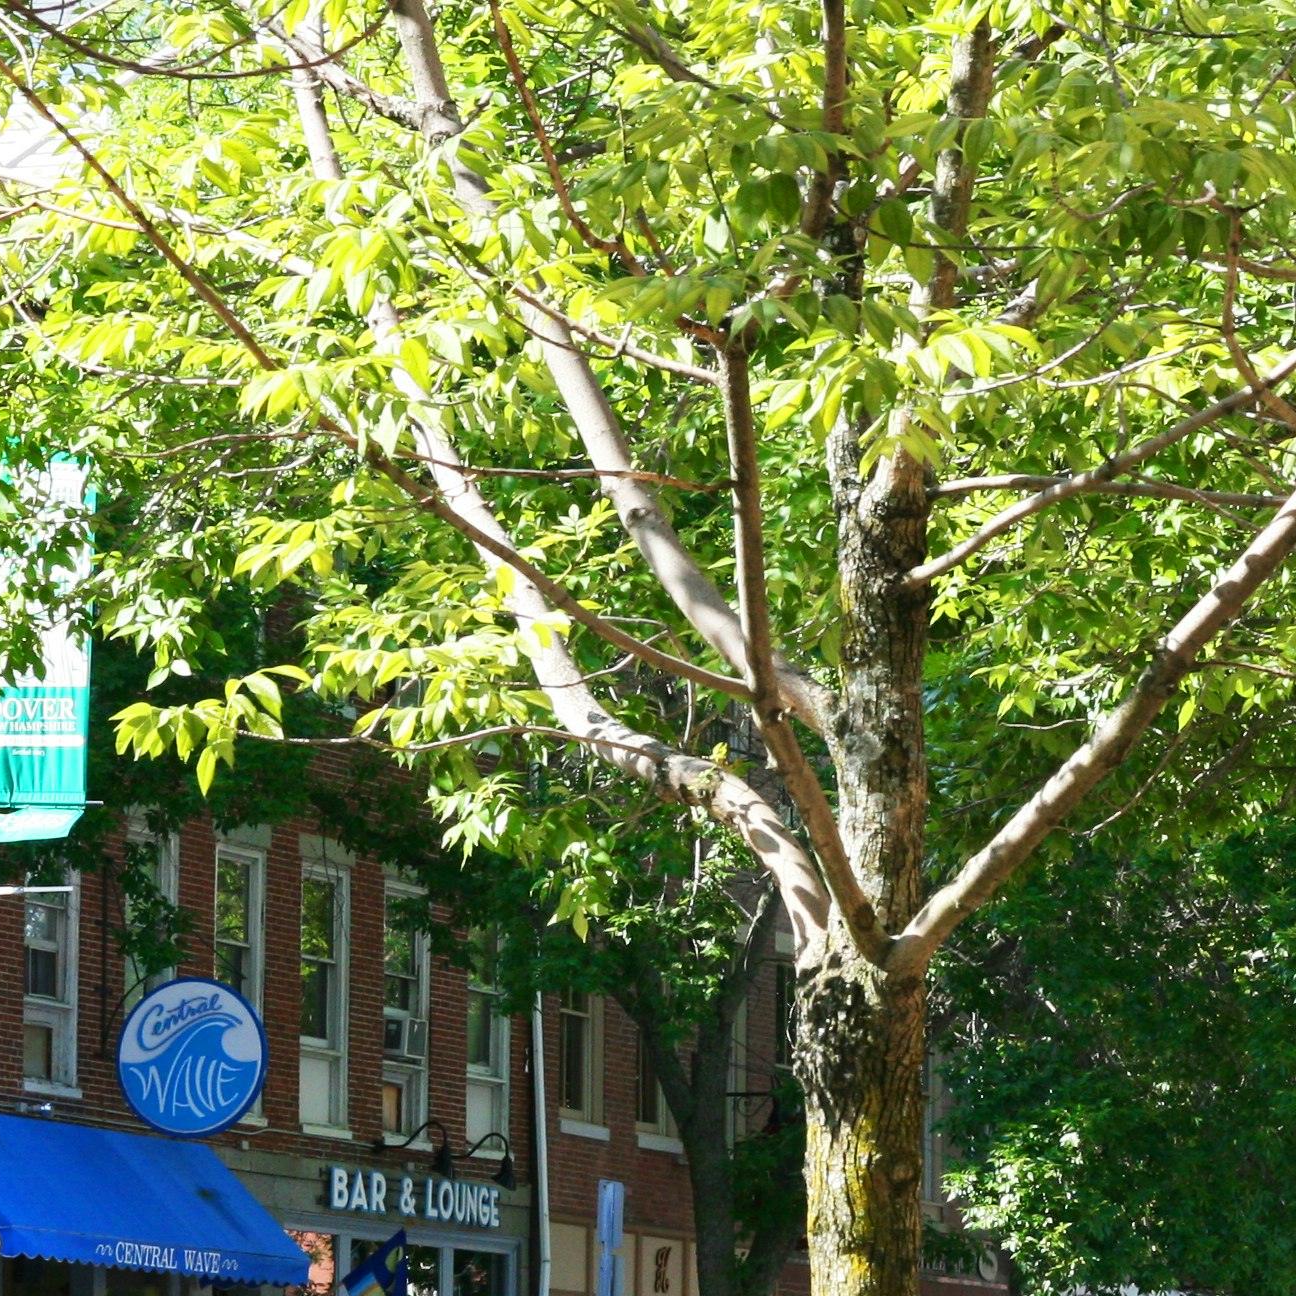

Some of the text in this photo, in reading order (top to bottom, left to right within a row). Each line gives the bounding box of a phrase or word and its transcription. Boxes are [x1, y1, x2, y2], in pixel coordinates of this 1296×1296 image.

[9, 721, 76, 732] HAMPSHIRE
[137, 993, 223, 1051] Central
[129, 1052, 245, 1118] WAVE
[330, 1165, 500, 1227] BAR & LOUNGE
[115, 1241, 221, 1274] CENTRAL WAVE
